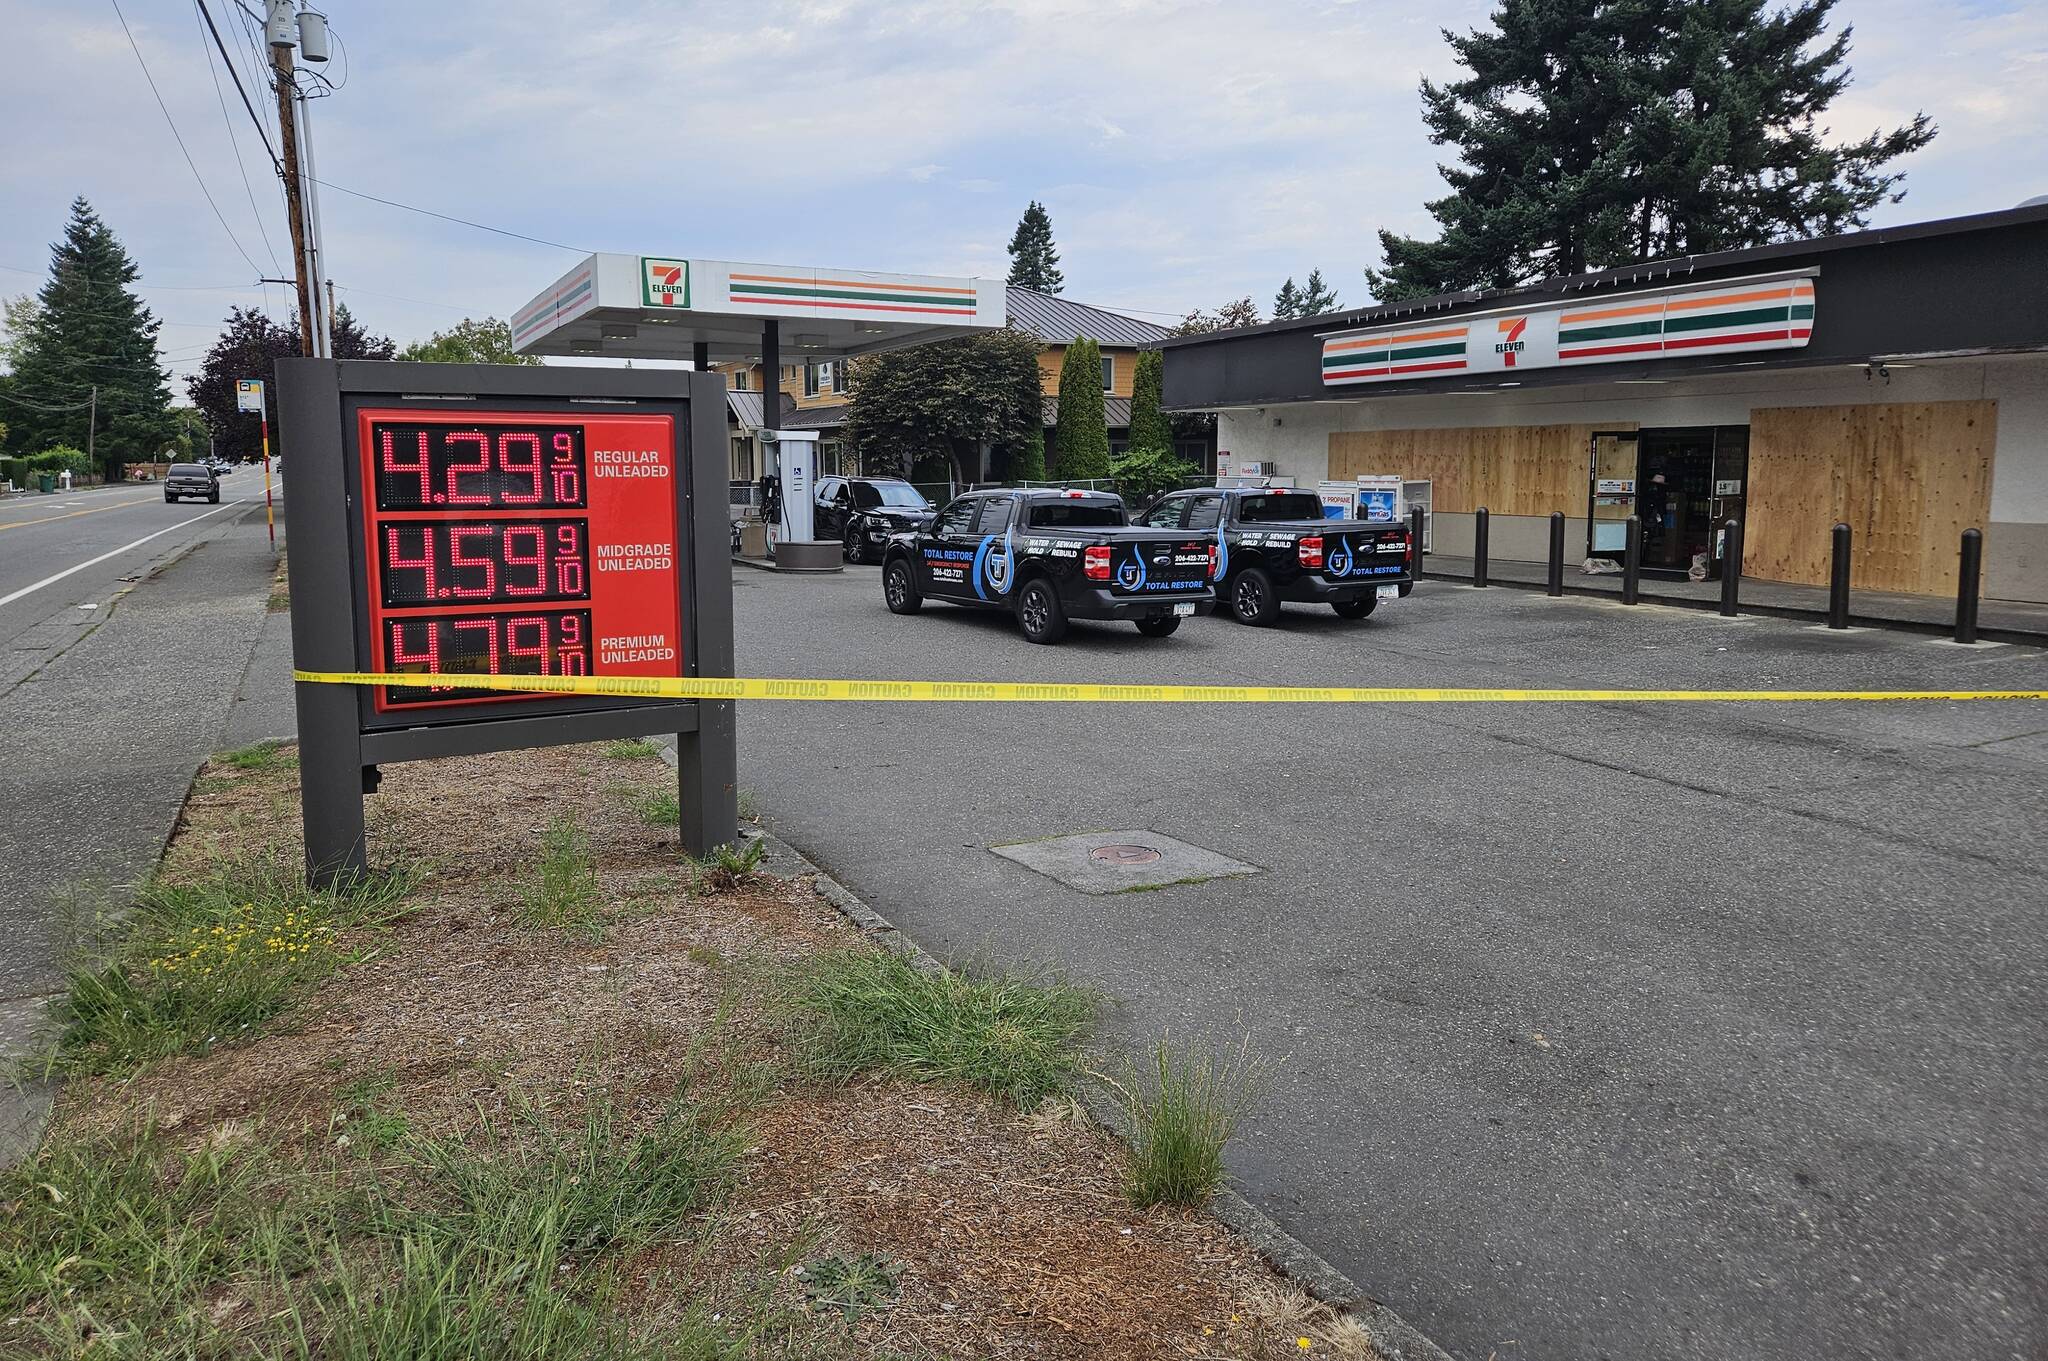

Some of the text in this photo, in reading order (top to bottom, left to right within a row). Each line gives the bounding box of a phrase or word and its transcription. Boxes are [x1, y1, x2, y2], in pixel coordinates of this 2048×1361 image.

[653, 266, 681, 305] 7
[1498, 316, 1527, 367] 7
[594, 451, 659, 463] REGULAR
[383, 431, 542, 503] 4.29
[594, 465, 669, 477] UNLEADED
[597, 544, 672, 557] MIDGRADE
[1029, 539, 1082, 549] WATER SEWAGE
[924, 549, 974, 561] TOTAL RESTORE
[1051, 549, 1077, 558] REBUILD
[388, 527, 546, 598] 4.59
[598, 558, 672, 571] UNLEADED
[1353, 566, 1401, 576] TOTAL RESTORE
[1146, 580, 1204, 590] TOTAL RESTORE
[601, 635, 664, 650] PREMIUM
[601, 648, 674, 664] UNLEADED
